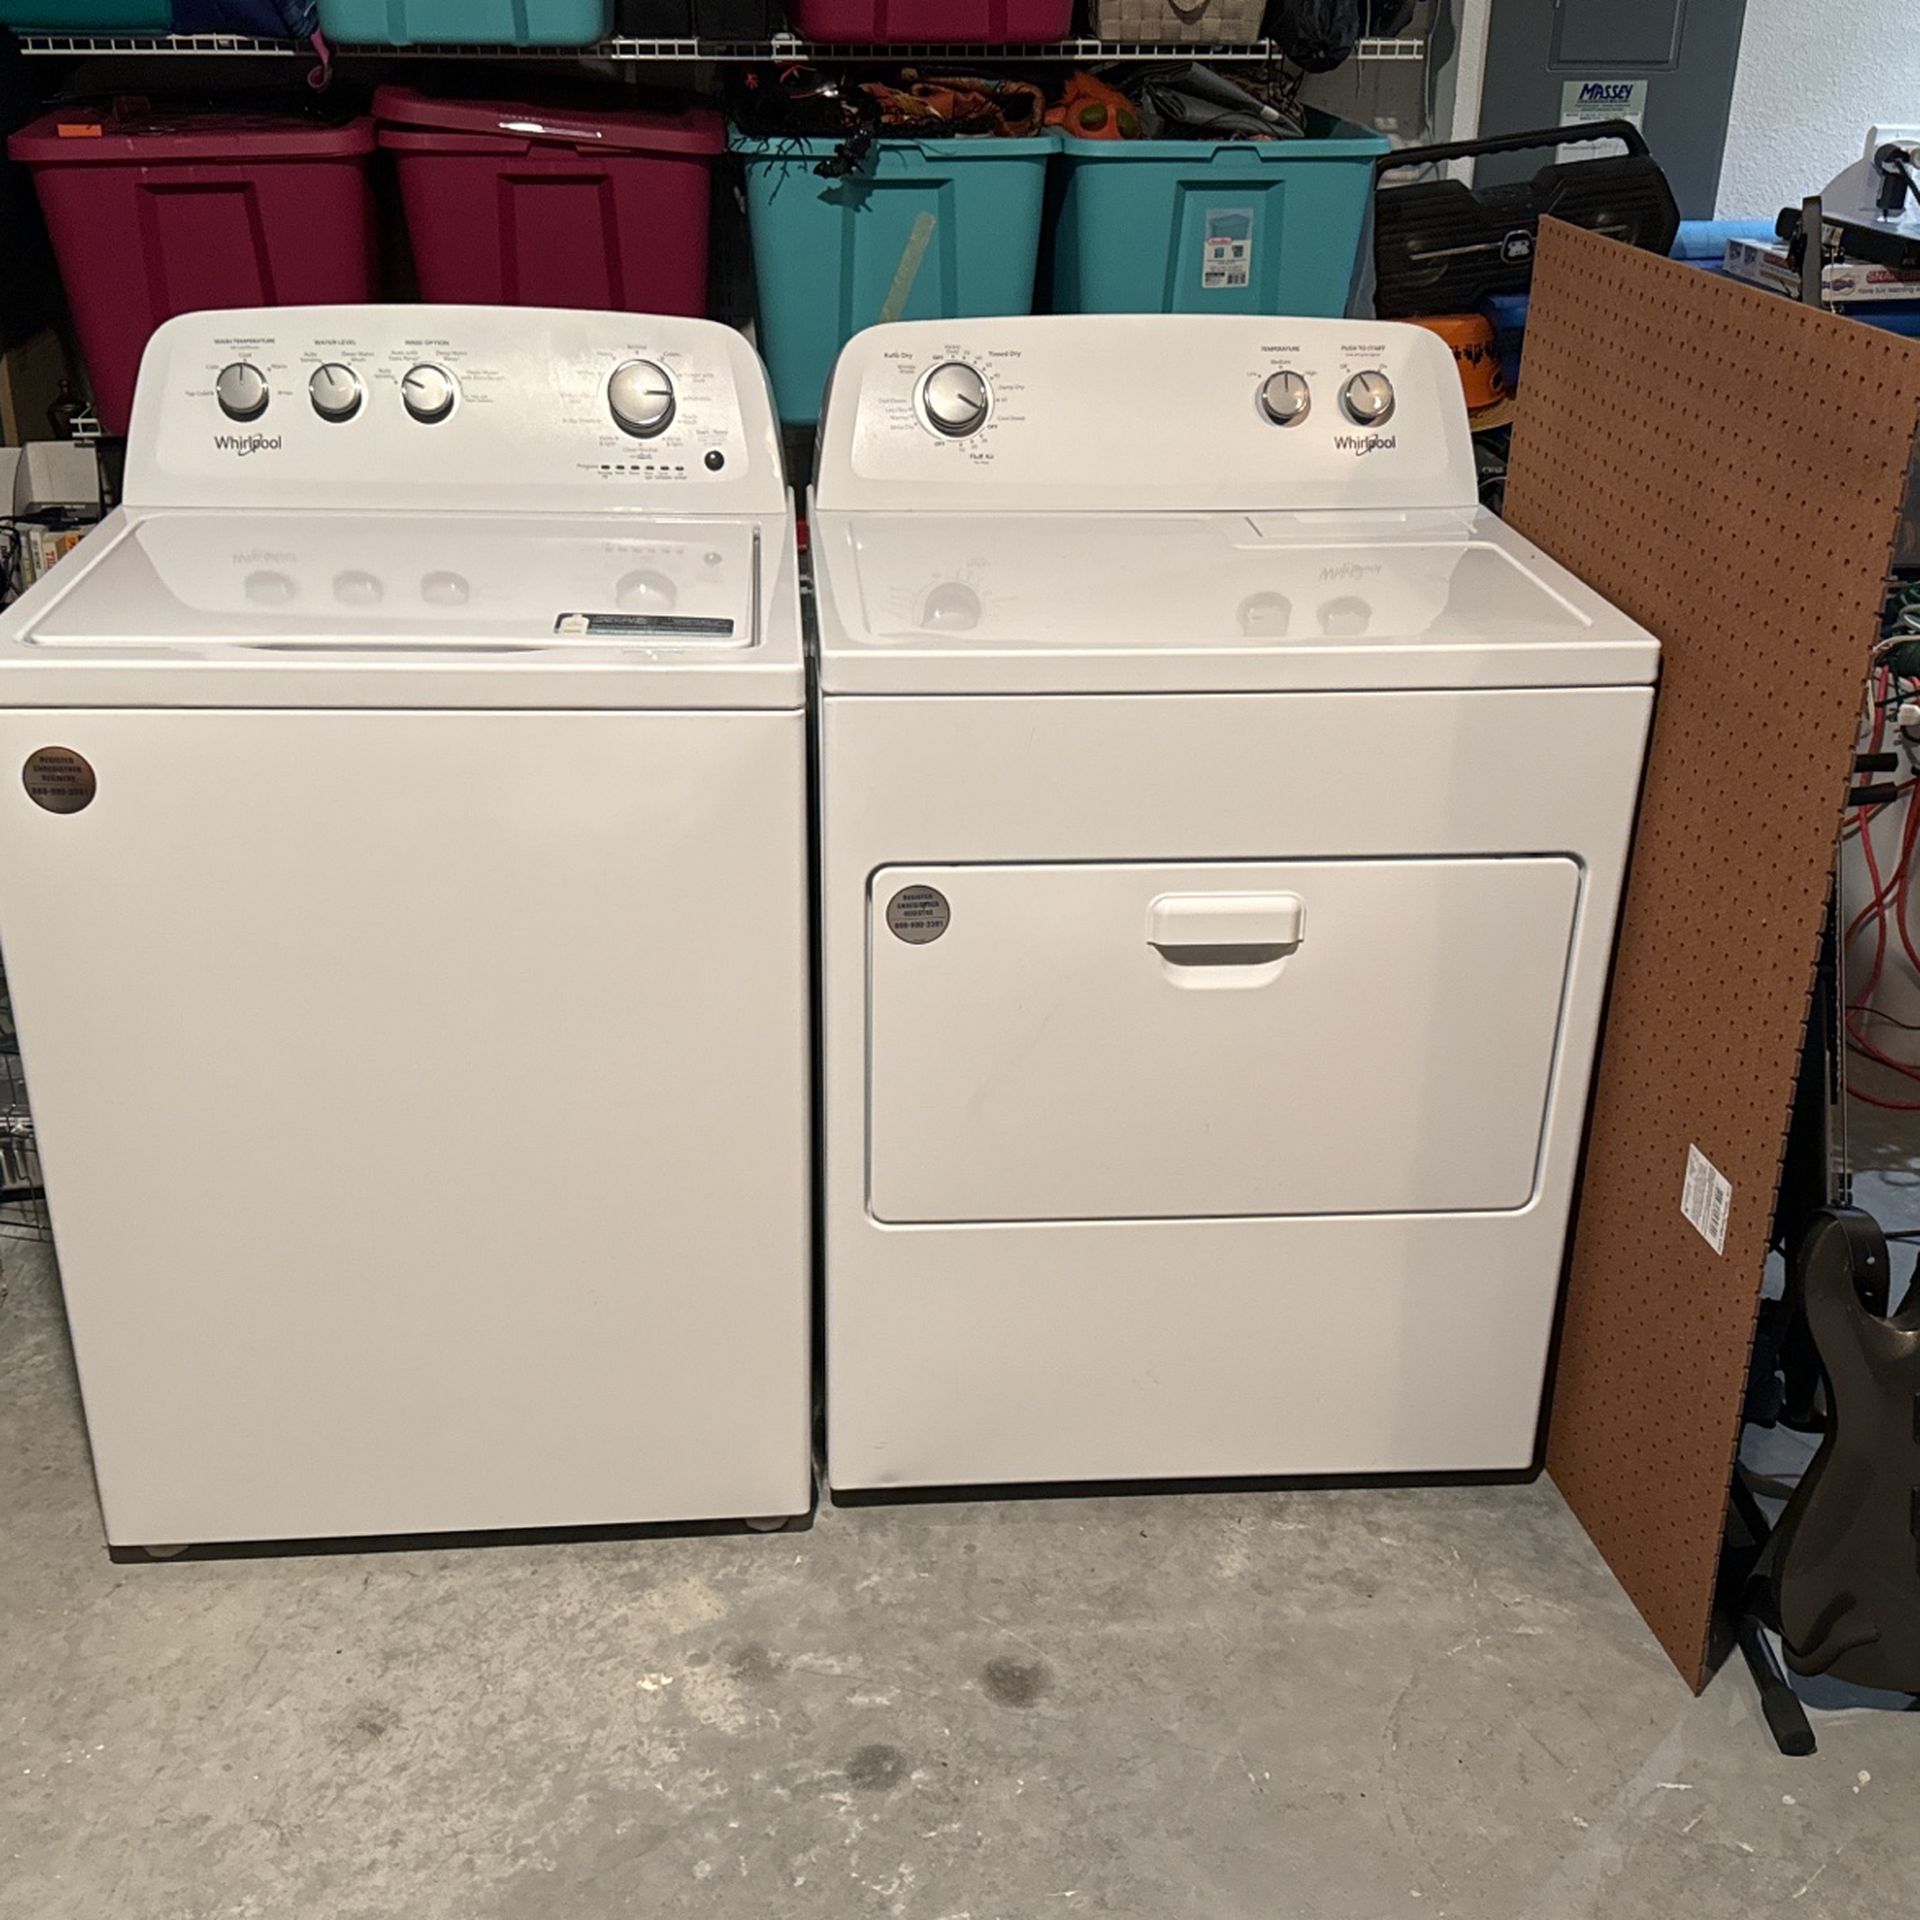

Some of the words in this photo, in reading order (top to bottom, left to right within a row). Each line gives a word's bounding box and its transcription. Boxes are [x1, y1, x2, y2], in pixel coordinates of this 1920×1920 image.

[1579, 83, 1633, 100] MASSEY
[214, 434, 282, 456] Whirlpool
[1334, 434, 1396, 456] Whirlpool
